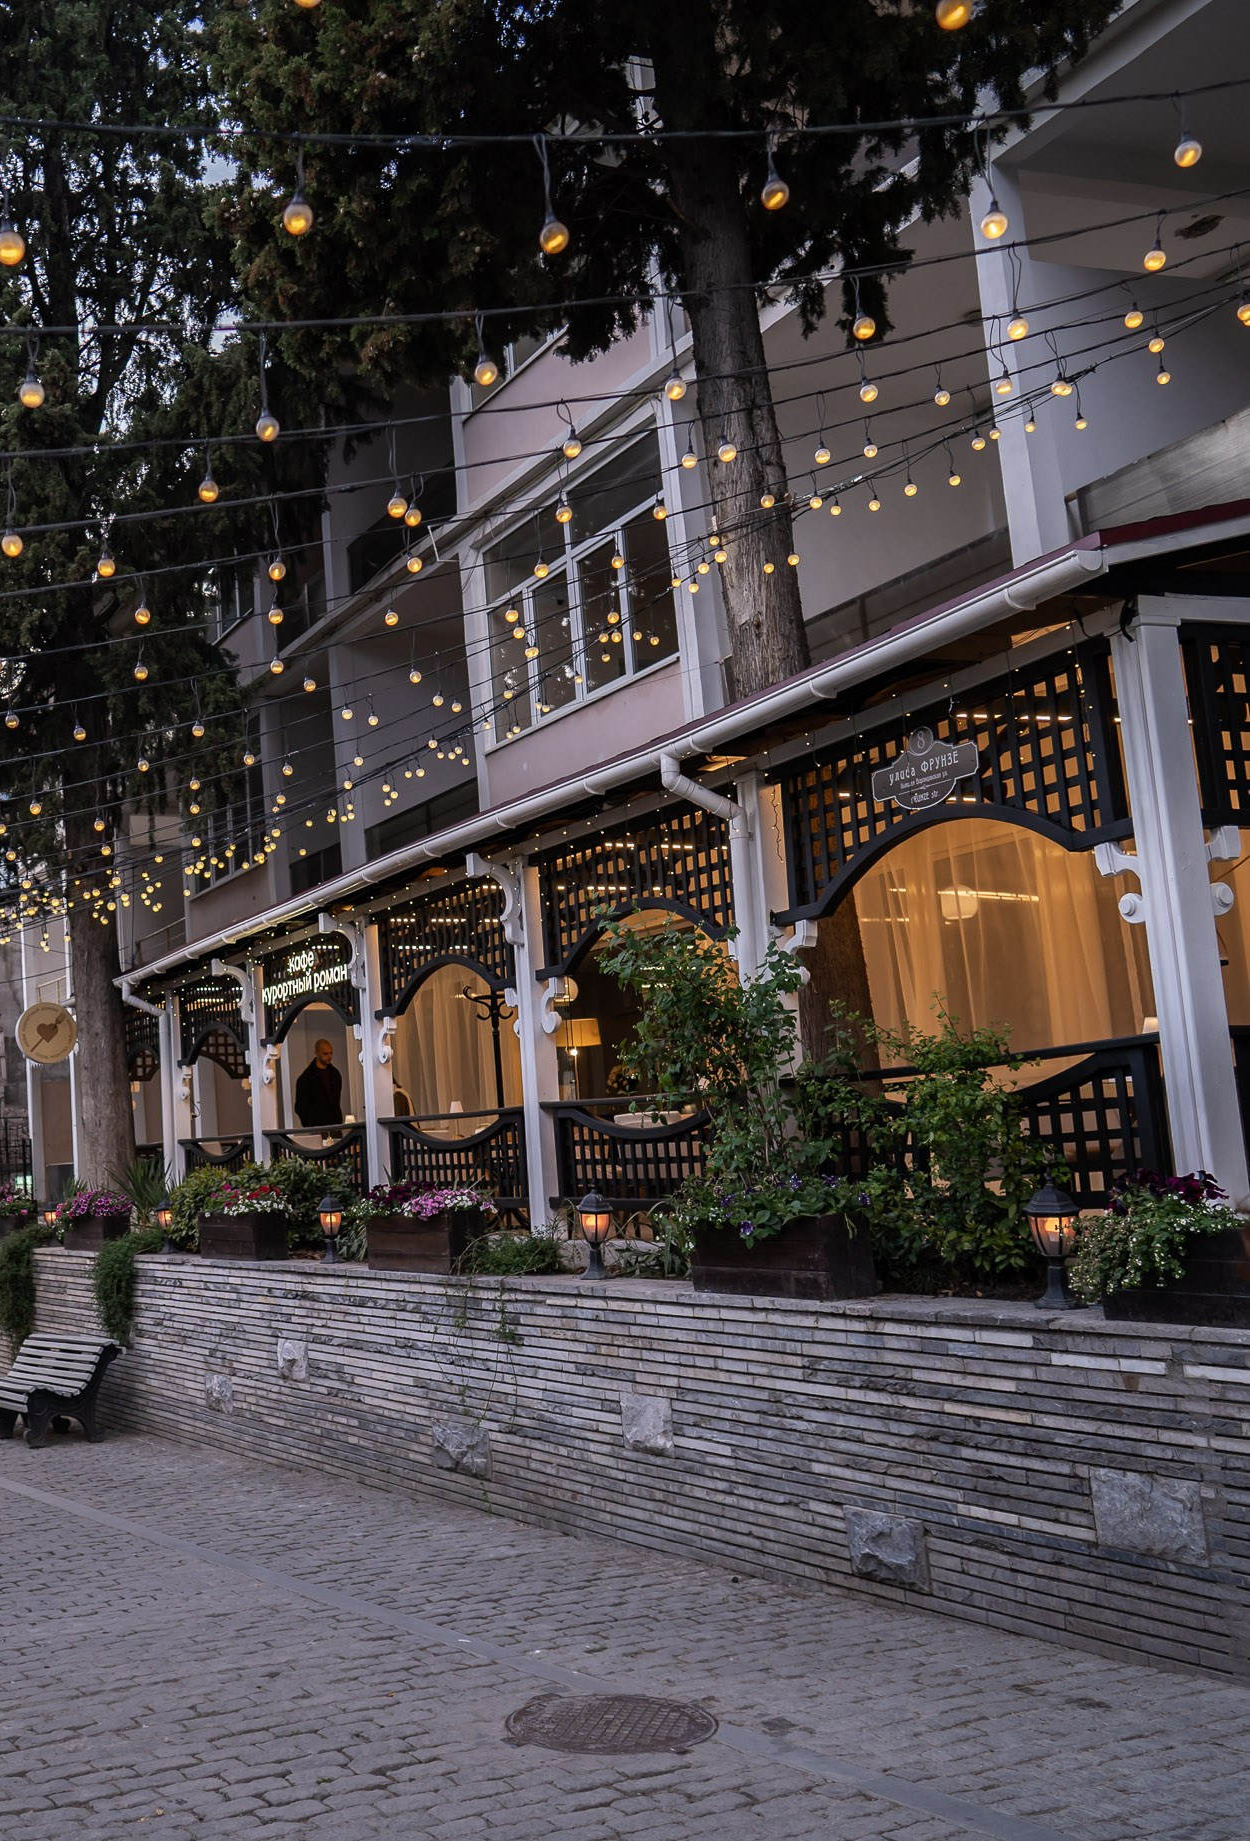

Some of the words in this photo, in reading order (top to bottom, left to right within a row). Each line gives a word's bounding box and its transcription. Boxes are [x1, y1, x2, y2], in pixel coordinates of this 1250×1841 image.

[917, 730, 925, 749] 8
[920, 751, 959, 773] ФРУНЗЕ
[288, 950, 315, 973] кафе
[262, 968, 312, 1006] курортный
[313, 963, 348, 993] роман
